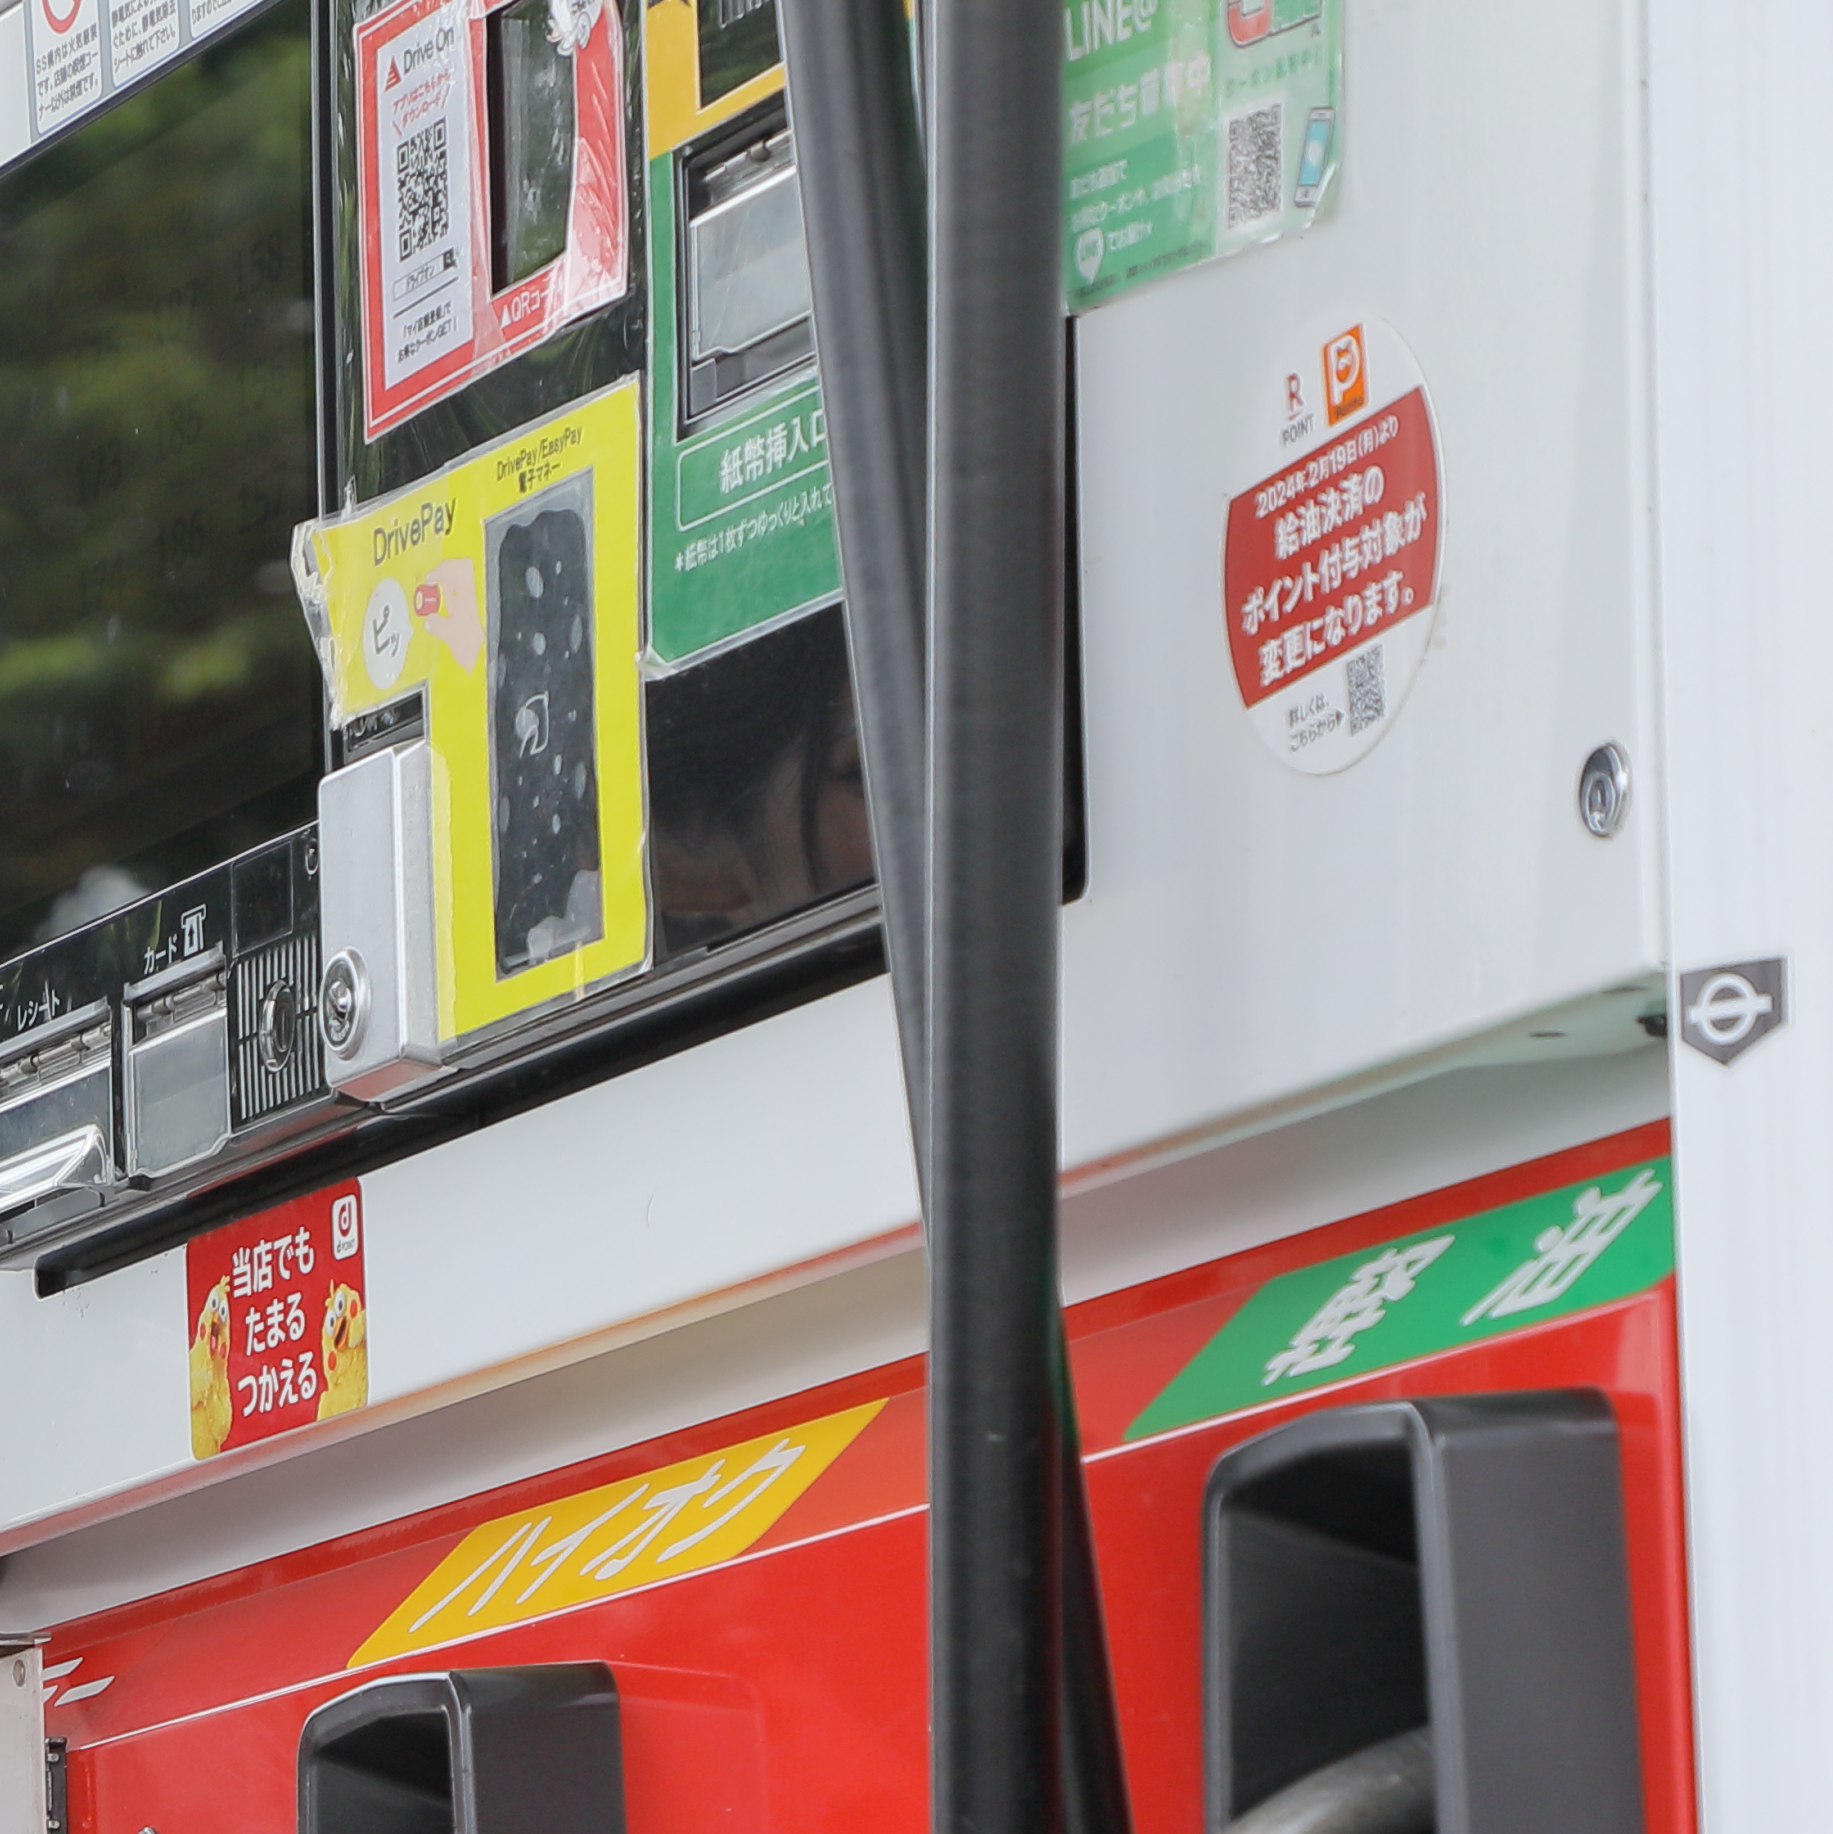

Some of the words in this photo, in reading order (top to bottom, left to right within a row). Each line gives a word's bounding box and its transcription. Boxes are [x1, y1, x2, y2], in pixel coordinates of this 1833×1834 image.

[403, 40, 434, 75] Drive
[720, 408, 828, 494] 紙幣挿入口
[1281, 413, 1315, 447] POINT
[373, 497, 456, 566] DrivePay
[1274, 466, 1385, 560] 給油決済の
[1242, 491, 1428, 636] ポイント付与対象が
[144, 934, 179, 975] カード
[17, 989, 61, 1031] レシート
[232, 1226, 315, 1298] 当店でも
[245, 1292, 306, 1357] たまる
[237, 1351, 318, 1417] つかえる
[408, 1437, 807, 1634] ハイオク
